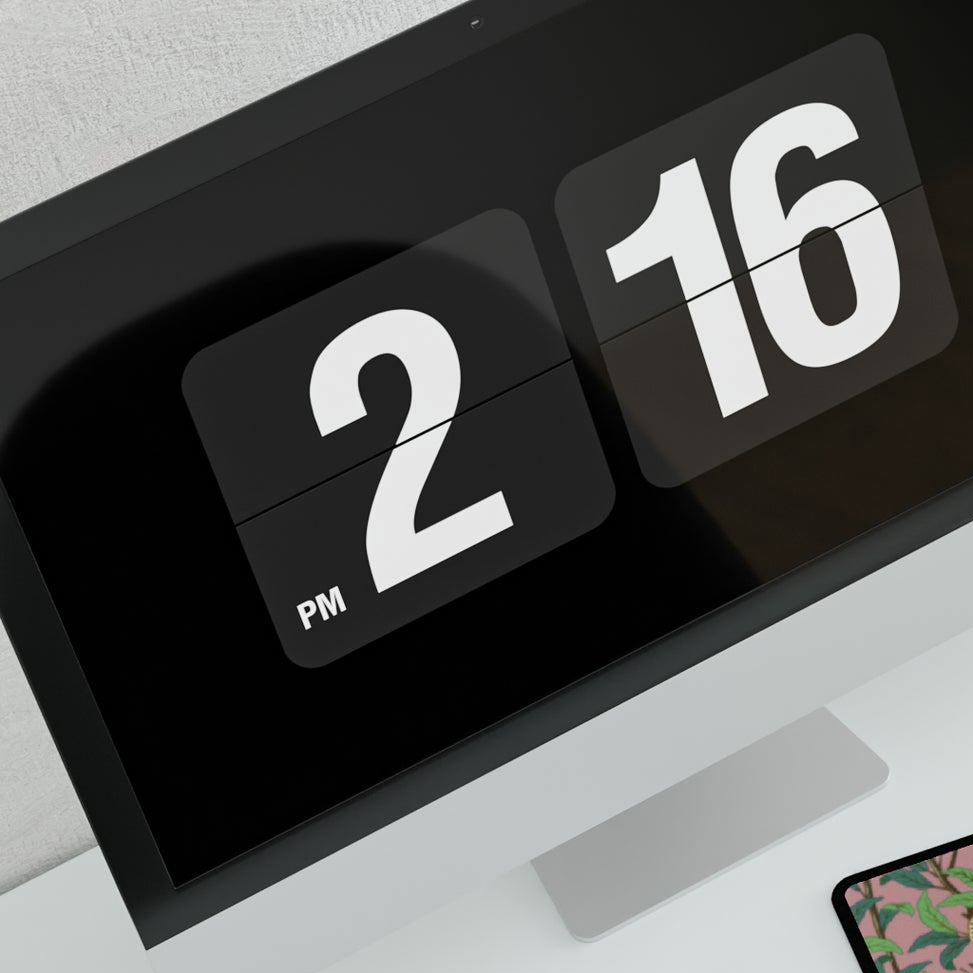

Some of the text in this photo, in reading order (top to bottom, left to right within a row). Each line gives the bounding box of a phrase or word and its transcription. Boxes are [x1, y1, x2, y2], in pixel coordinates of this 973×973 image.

[309, 102, 901, 594] 2 16
[296, 585, 347, 631] PM
